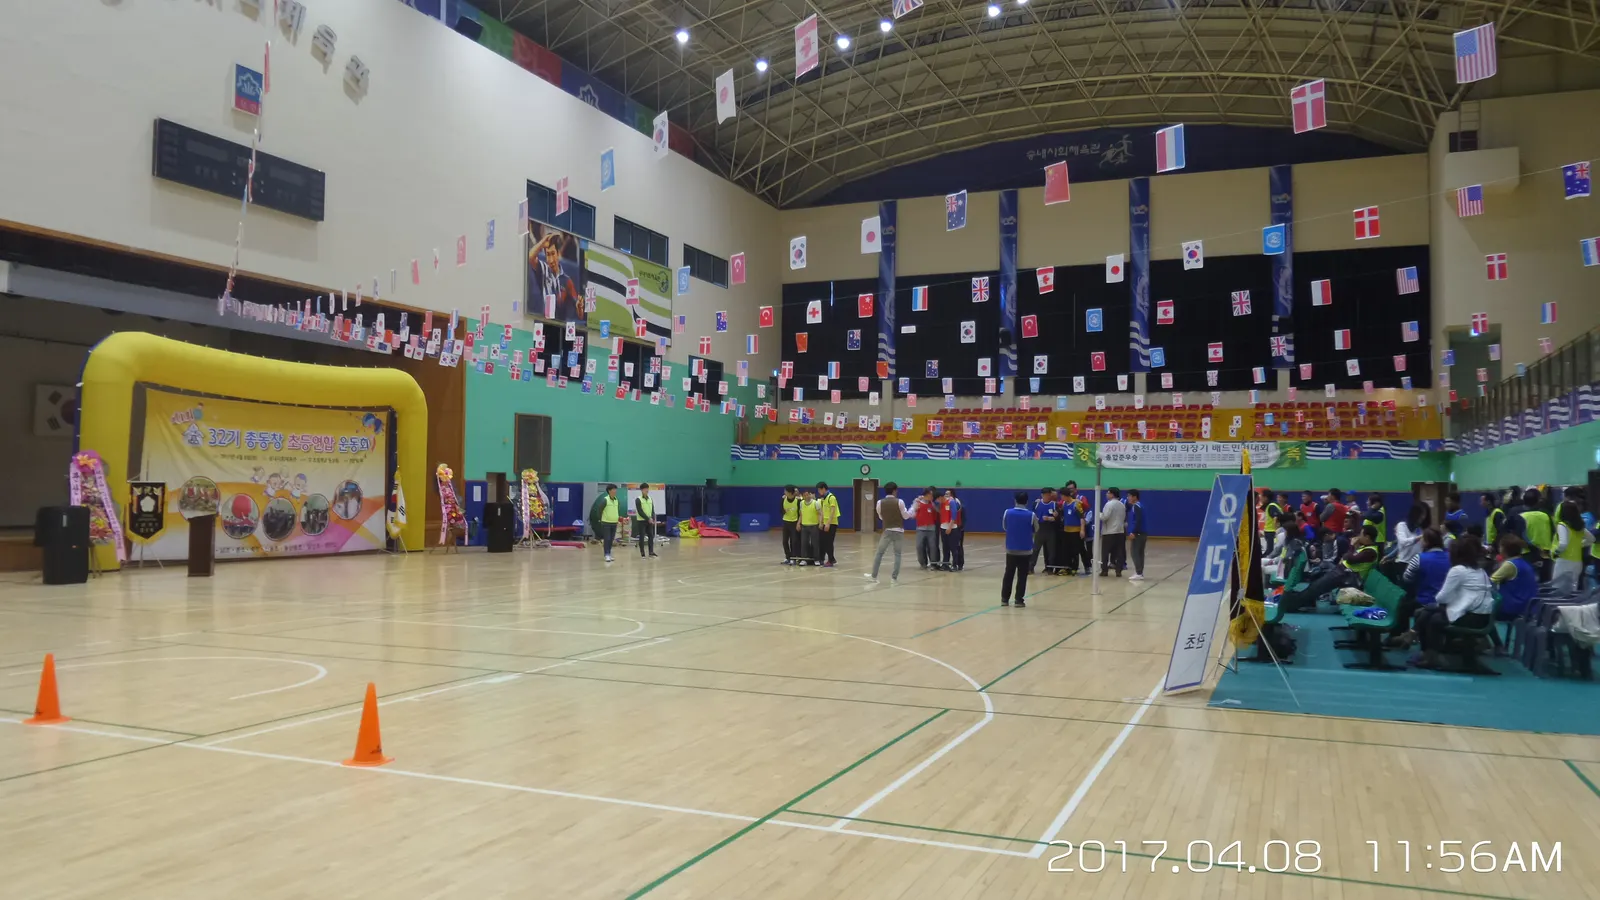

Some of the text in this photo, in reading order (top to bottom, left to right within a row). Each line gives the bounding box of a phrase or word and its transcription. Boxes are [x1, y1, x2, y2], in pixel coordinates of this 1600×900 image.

[208, 427, 240, 448] 32기
[288, 433, 335, 453] 초등연합
[338, 435, 371, 454] 운동회
[1077, 447, 1090, 461] 경
[1105, 444, 1128, 453] 2017
